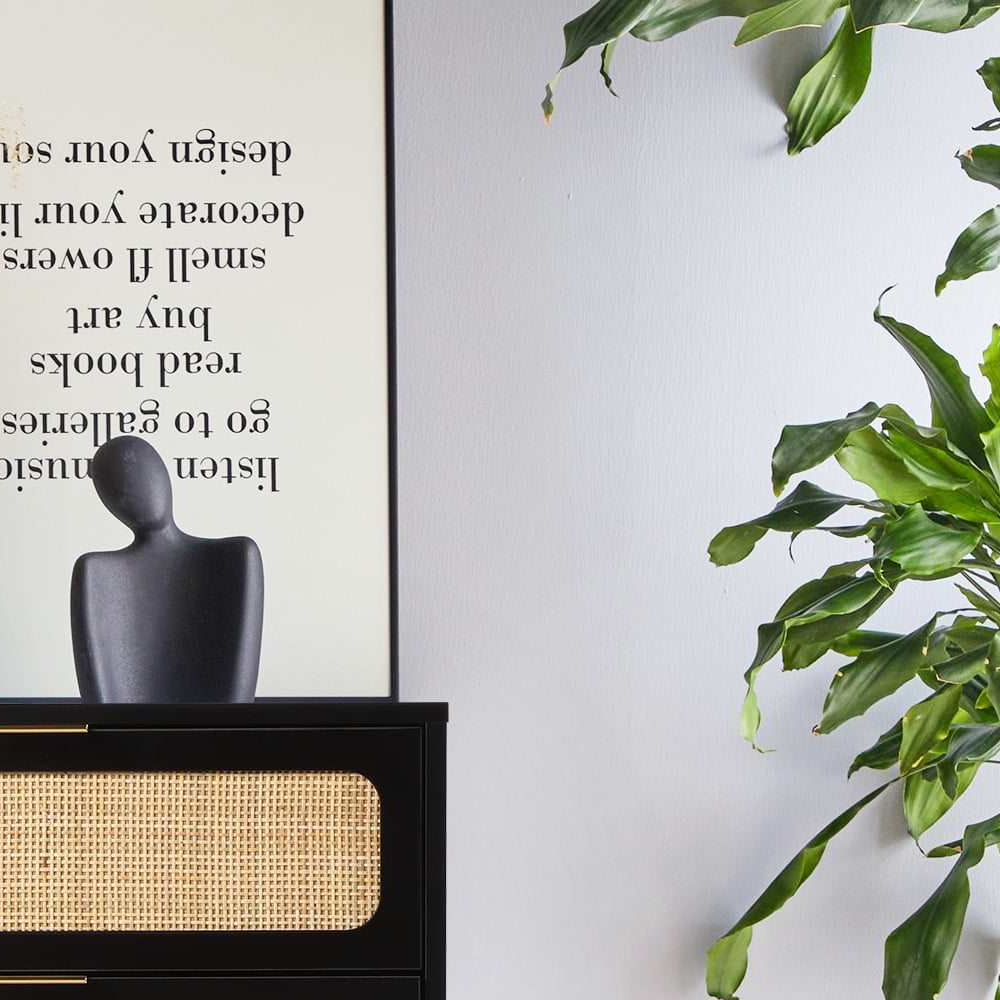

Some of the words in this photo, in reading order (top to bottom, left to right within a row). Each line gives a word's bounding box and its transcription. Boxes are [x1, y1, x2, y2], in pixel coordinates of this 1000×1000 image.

[65, 128, 155, 164] your
[168, 128, 292, 176] design
[34, 189, 126, 225] your
[139, 201, 305, 238] decorate
[168, 248, 266, 284] smell
[67, 307, 122, 335] art
[136, 294, 213, 342] buy
[30, 352, 144, 388] books
[157, 352, 242, 388] read
[2, 399, 159, 447] galleries
[174, 412, 213, 440] to
[226, 399, 270, 447] go
[173, 458, 279, 492] listen
